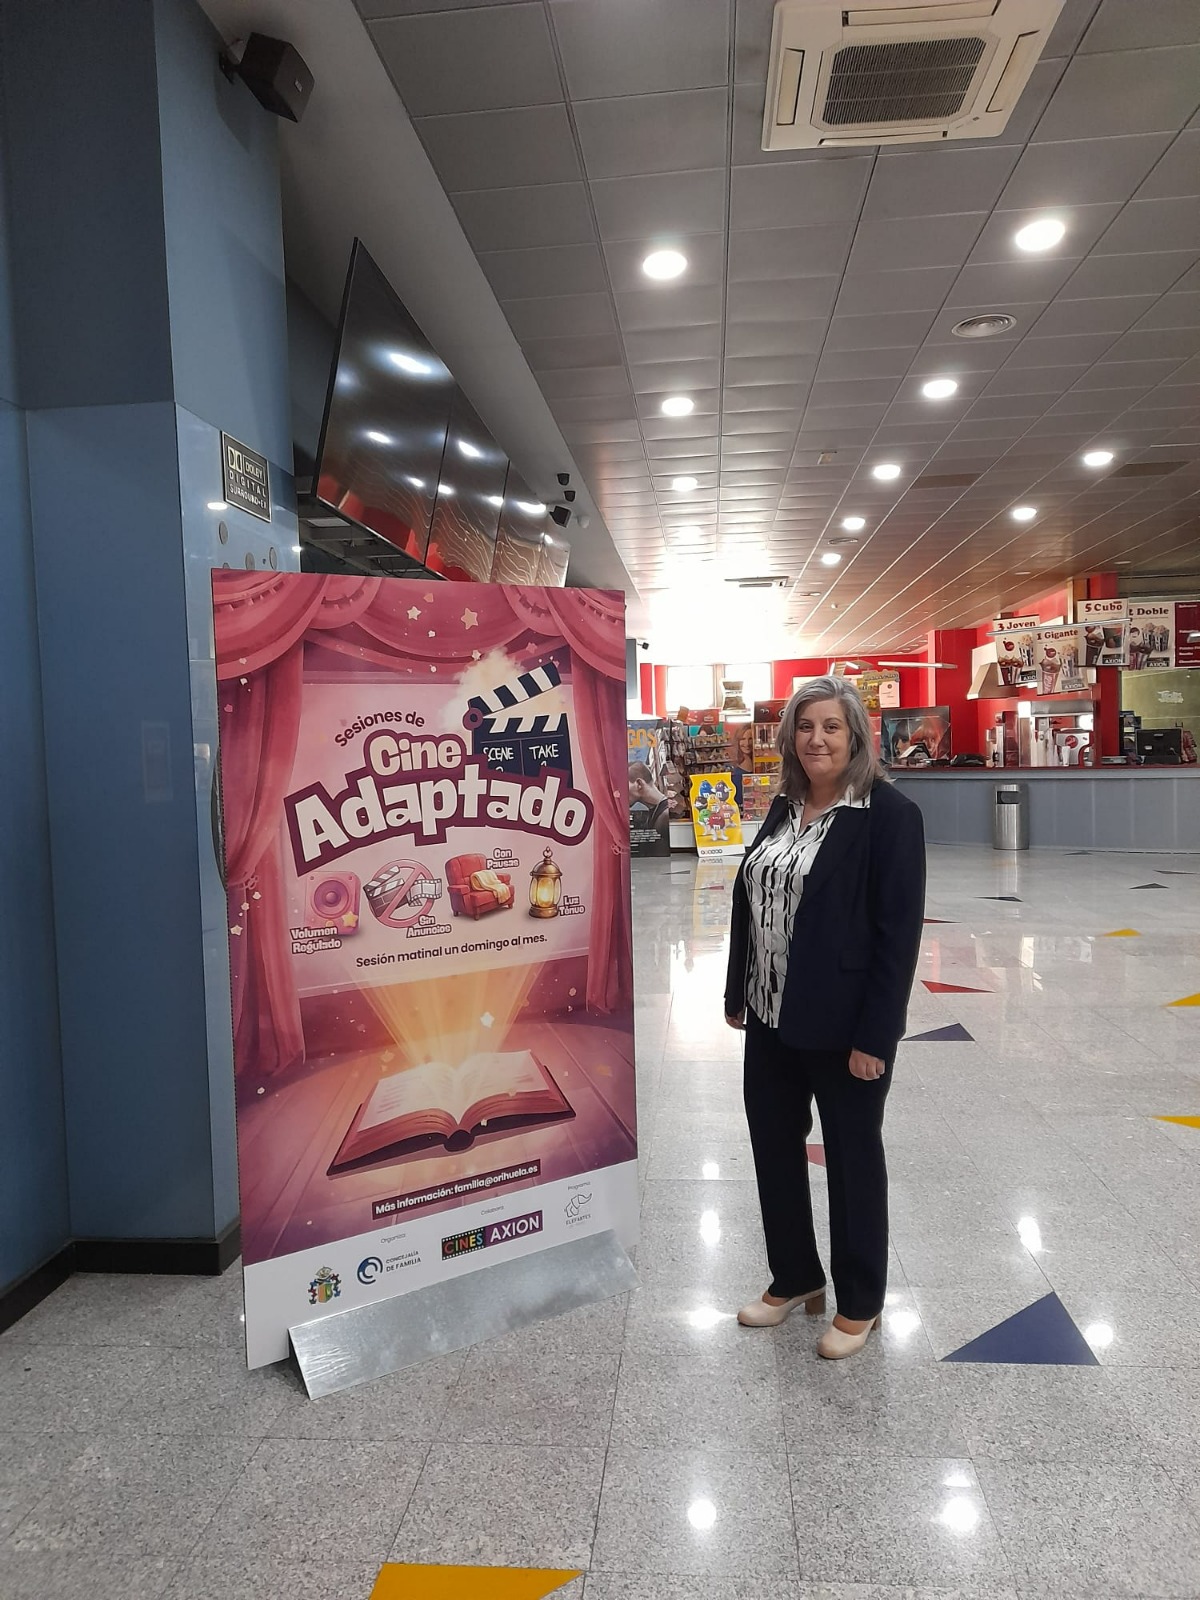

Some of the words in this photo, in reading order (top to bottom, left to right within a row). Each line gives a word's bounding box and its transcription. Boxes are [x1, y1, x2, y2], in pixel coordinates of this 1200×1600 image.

[245, 461, 263, 479] DOLBY
[229, 470, 266, 497] DIGITAL
[1085, 603, 1092, 612] 5
[1094, 603, 1122, 612] Cubo
[1137, 607, 1169, 616] Doble
[997, 623, 1004, 631] 3
[1006, 620, 1036, 630] Joven
[1036, 632, 1042, 640] 1
[1044, 629, 1079, 641] Gigante
[334, 710, 402, 747] Sesiones
[405, 711, 425, 727] de
[368, 735, 462, 776] Cine
[483, 747, 515, 762] SCENE
[529, 744, 559, 759] TAKE
[292, 763, 588, 862] Adaptado
[493, 849, 512, 858] Con
[487, 859, 519, 869] Pausas
[419, 915, 435, 925] Sin
[291, 927, 338, 940] Volumen
[406, 924, 451, 937] Anuncios
[292, 939, 341, 954] Regulado
[356, 953, 395, 967] Sesión
[398, 946, 442, 961] matinal
[445, 946, 459, 956] un
[461, 939, 510, 954] domingo
[511, 935, 521, 946] al
[522, 934, 548, 945] mes.
[375, 1201, 396, 1215] Más
[397, 1186, 454, 1209] información:
[454, 1164, 538, 1194] familia@orihuela.es
[380, 1233, 406, 1244] Organiza
[444, 1232, 484, 1254] CINES
[490, 1216, 540, 1243] AXION
[386, 1264, 395, 1273] DE
[396, 1257, 421, 1270] FAMILIA
